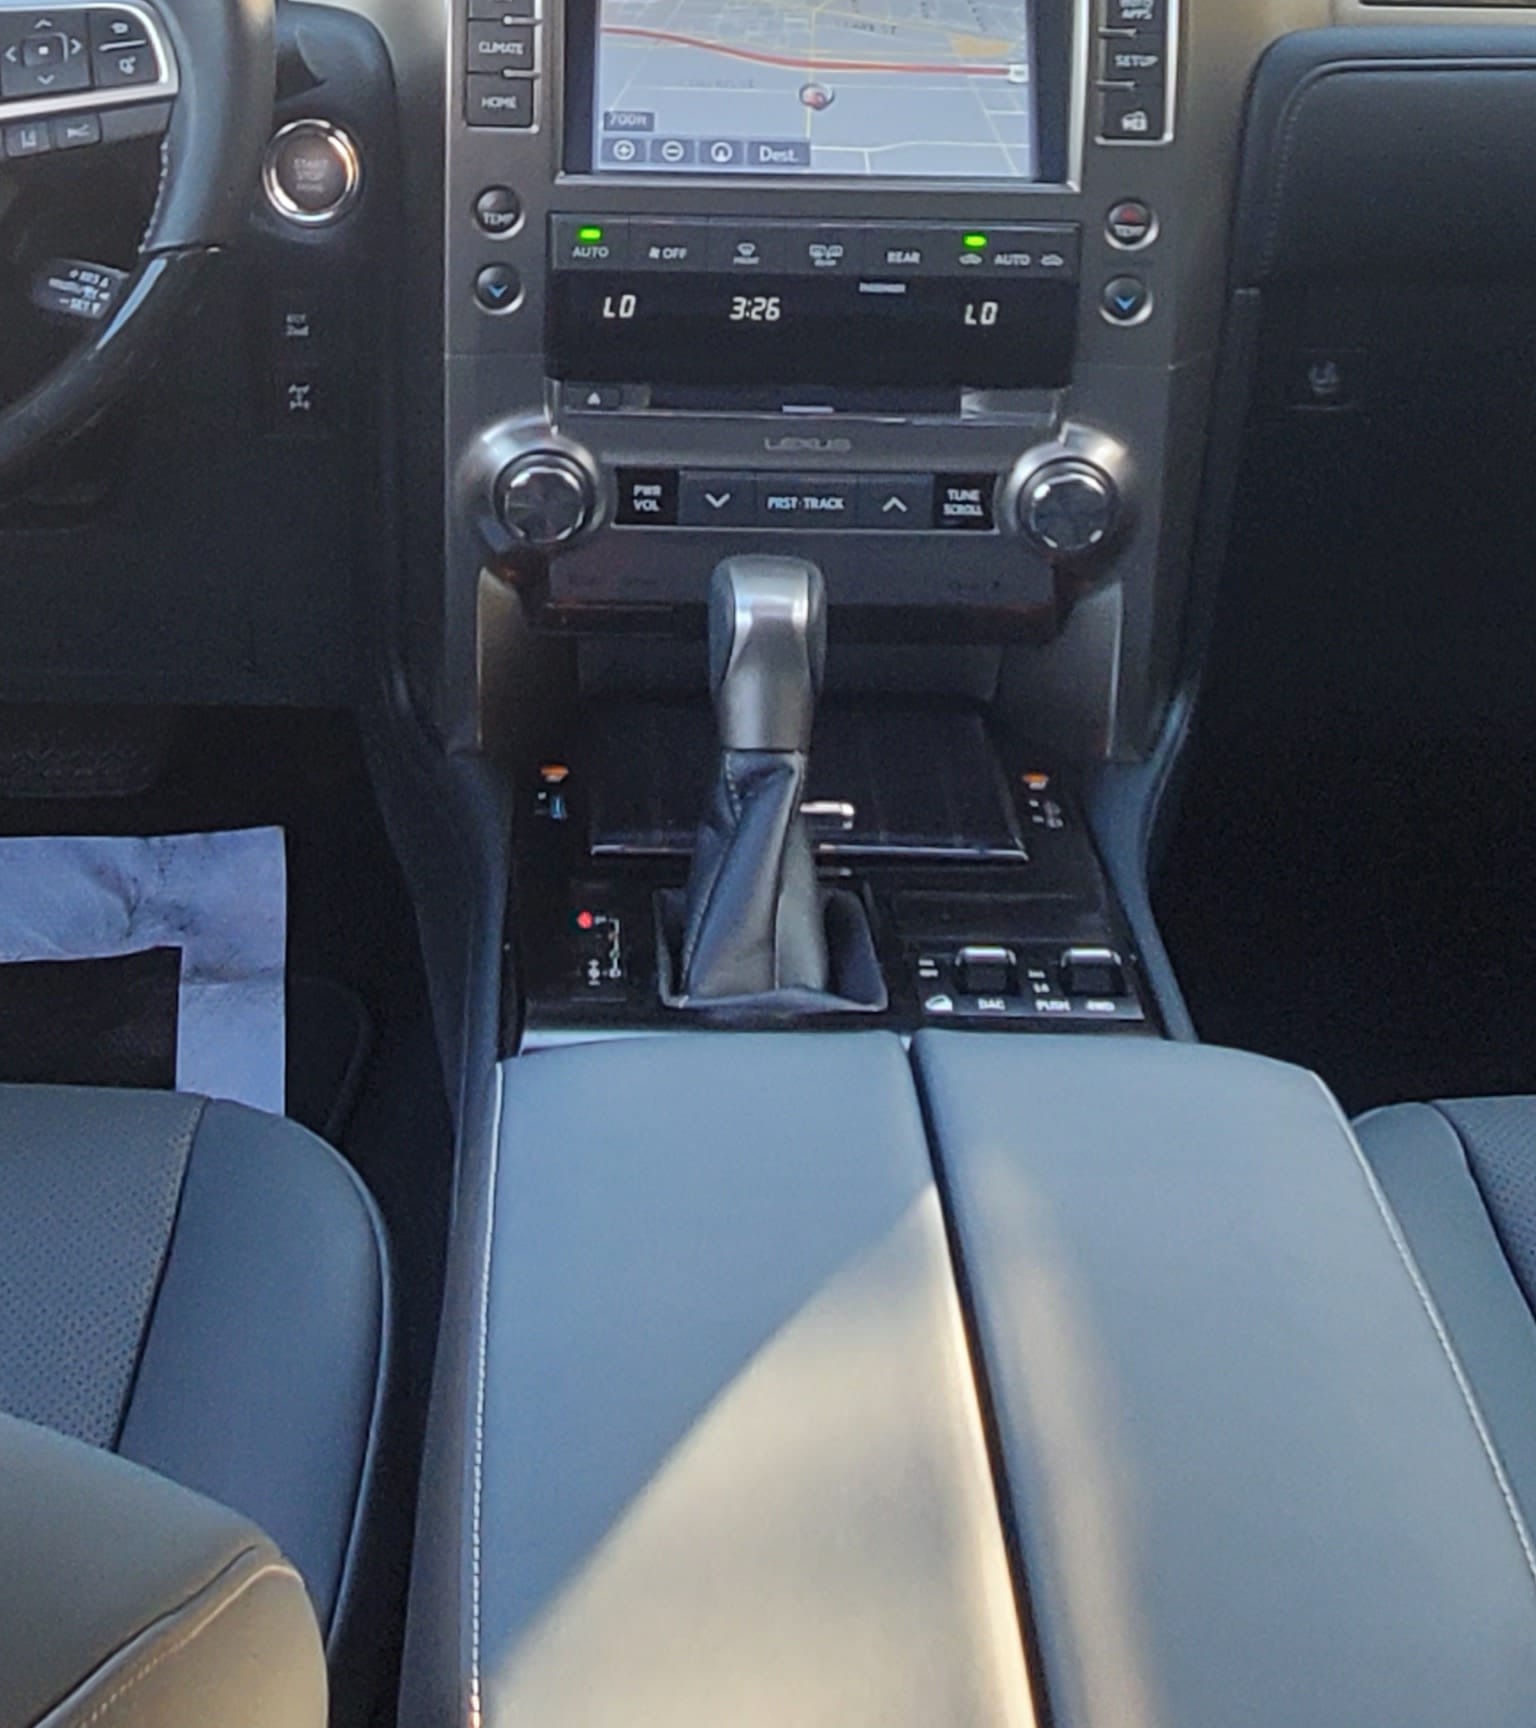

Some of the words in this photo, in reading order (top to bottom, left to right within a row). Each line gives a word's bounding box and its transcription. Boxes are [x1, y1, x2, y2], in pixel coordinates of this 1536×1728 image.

[478, 41, 525, 56] CLIMATE
[481, 96, 518, 110] HOME
[759, 145, 799, 163] Dest.
[482, 211, 515, 224] TEMP
[572, 246, 610, 259] AUTO
[662, 246, 688, 260] OFF
[887, 250, 921, 265] REAR
[994, 253, 1032, 268] AUTO
[603, 294, 637, 319] LO
[729, 296, 782, 321] 3:26
[964, 302, 999, 326] LO
[765, 436, 852, 452] LEXUS
[947, 488, 981, 502] TUNE
[633, 498, 662, 512] VOL
[977, 998, 1006, 1011] DAC
[1035, 999, 1072, 1012] PUSH
